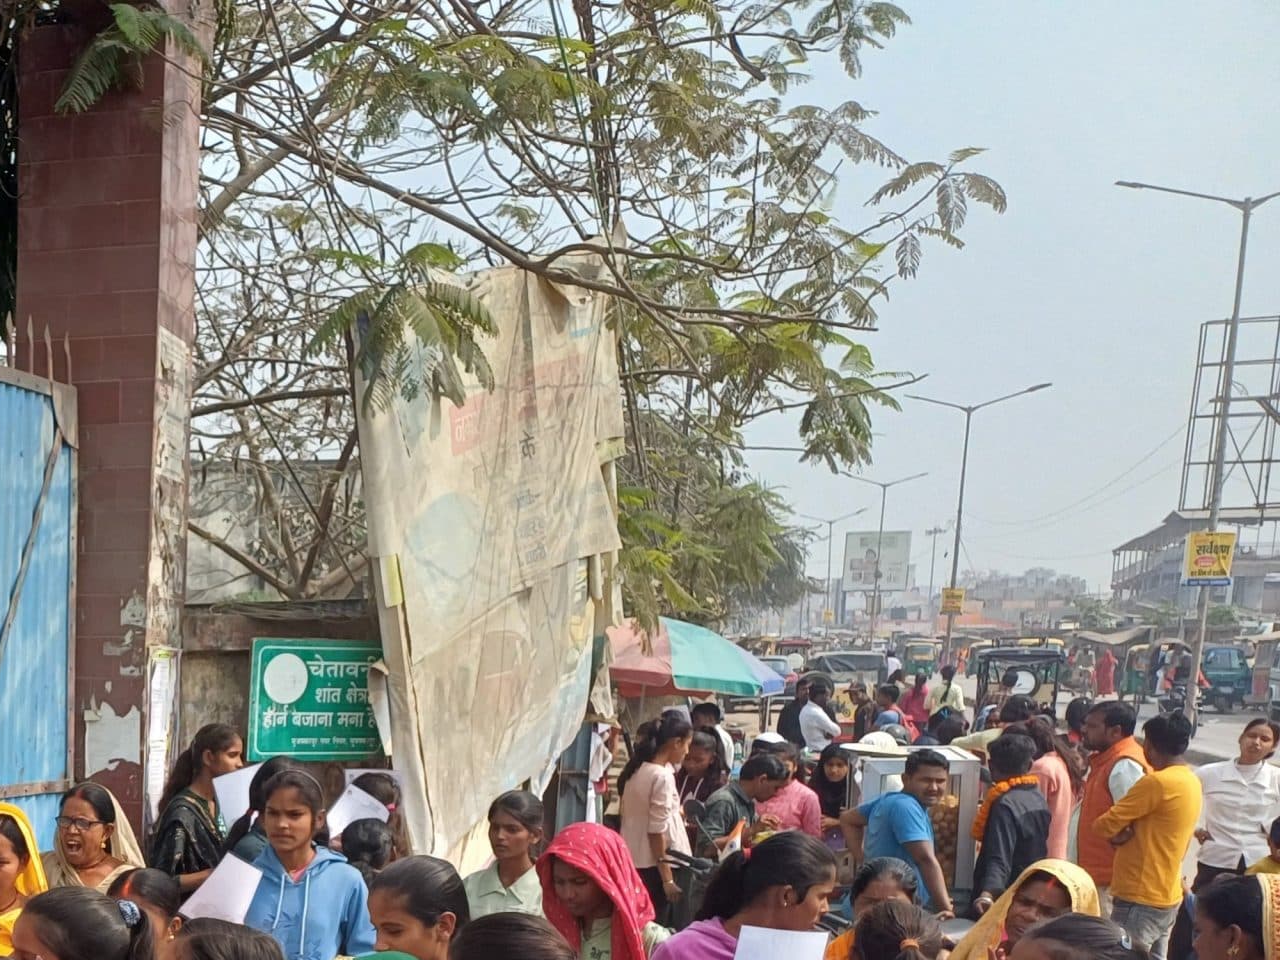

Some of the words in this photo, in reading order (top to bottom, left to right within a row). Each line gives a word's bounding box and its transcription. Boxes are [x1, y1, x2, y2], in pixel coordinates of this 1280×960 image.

[315, 682, 342, 704] शांत
[291, 711, 333, 728] बजाना
[337, 712, 364, 728] मना
